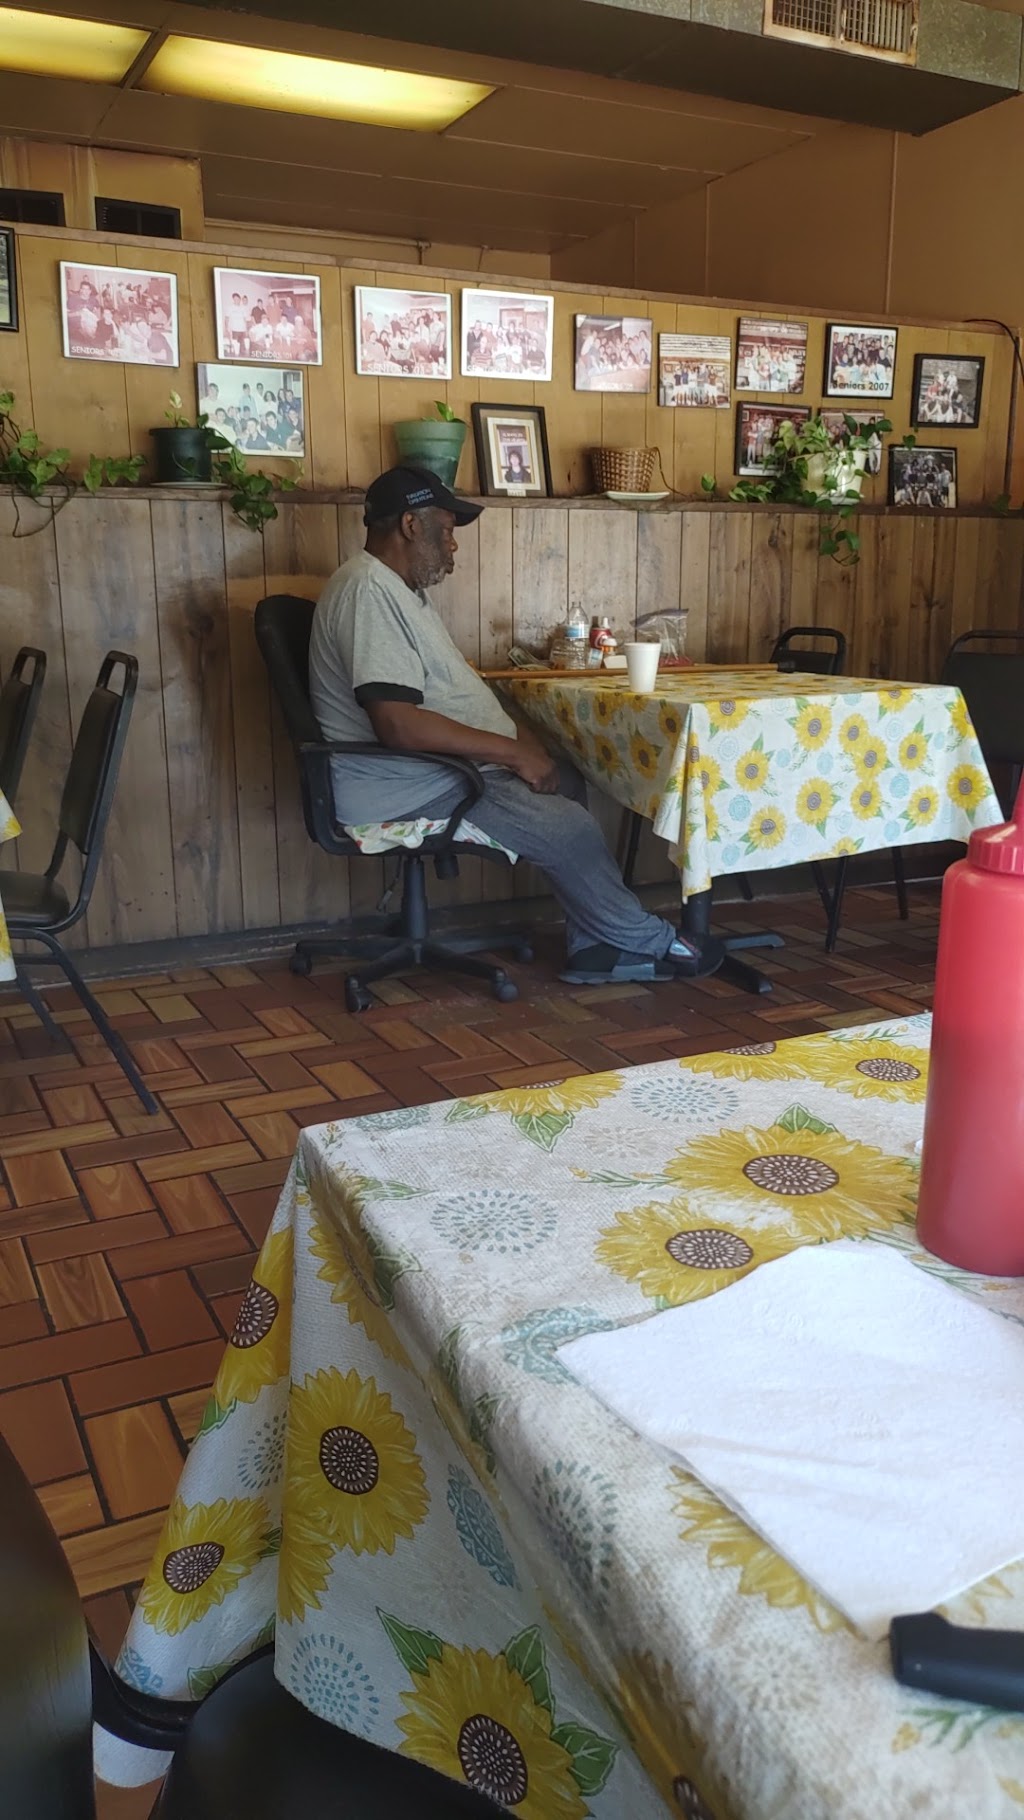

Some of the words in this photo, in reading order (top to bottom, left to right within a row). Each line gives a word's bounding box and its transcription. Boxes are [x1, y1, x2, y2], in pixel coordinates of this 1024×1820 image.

[71, 346, 104, 355] SENIORS
[832, 380, 865, 390] Seniors
[868, 381, 890, 391] 2007
